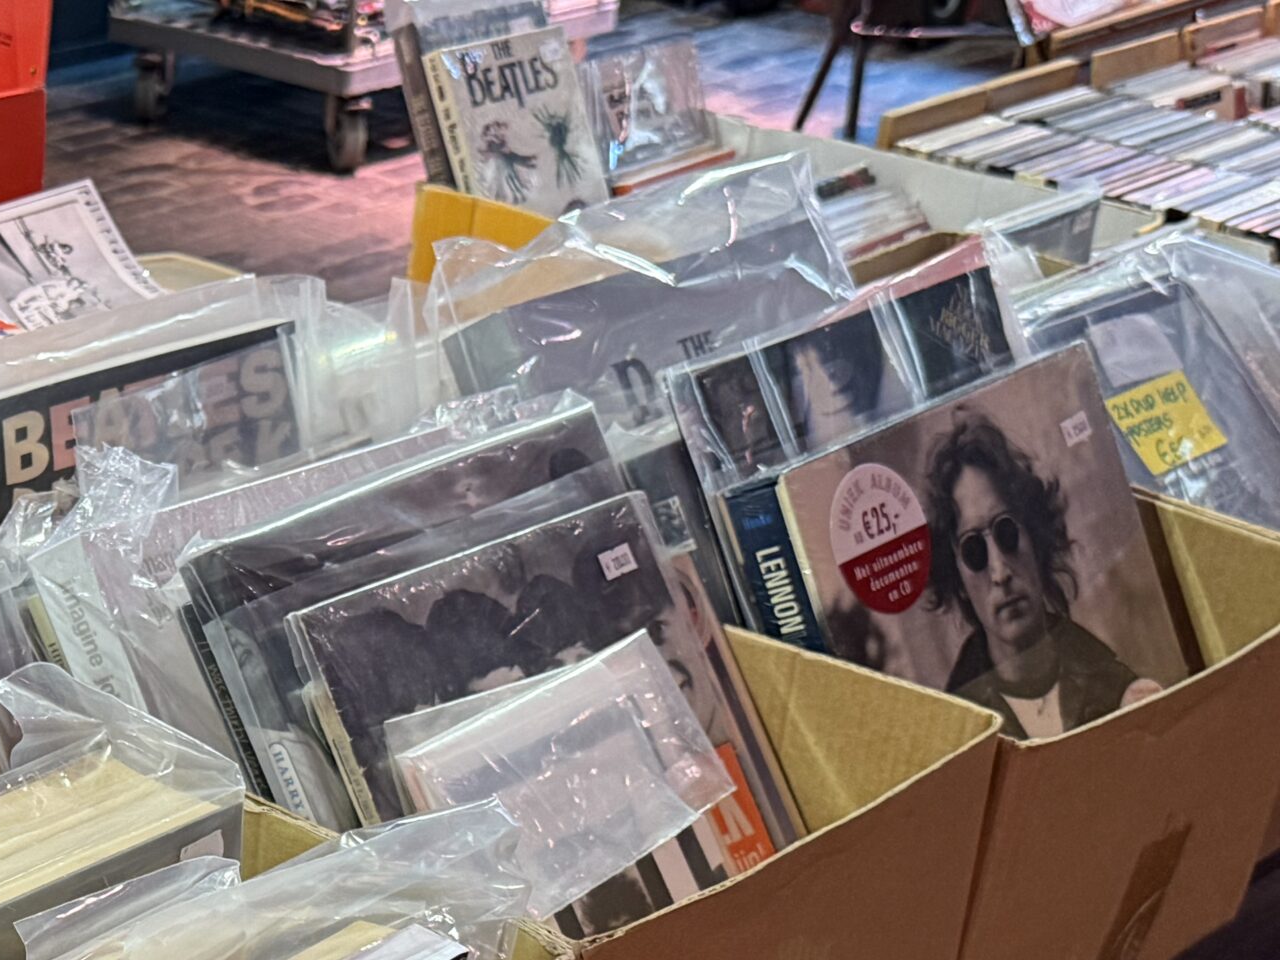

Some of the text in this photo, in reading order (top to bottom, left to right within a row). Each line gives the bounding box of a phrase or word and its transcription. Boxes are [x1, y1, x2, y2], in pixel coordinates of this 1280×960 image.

[490, 38, 512, 60] THE
[459, 53, 558, 108] BEATLES
[839, 473, 912, 532] UNIEK ALBUM
[755, 545, 806, 635] LENNON
[869, 560, 919, 593] documenten
[272, 751, 306, 812] HARRY
